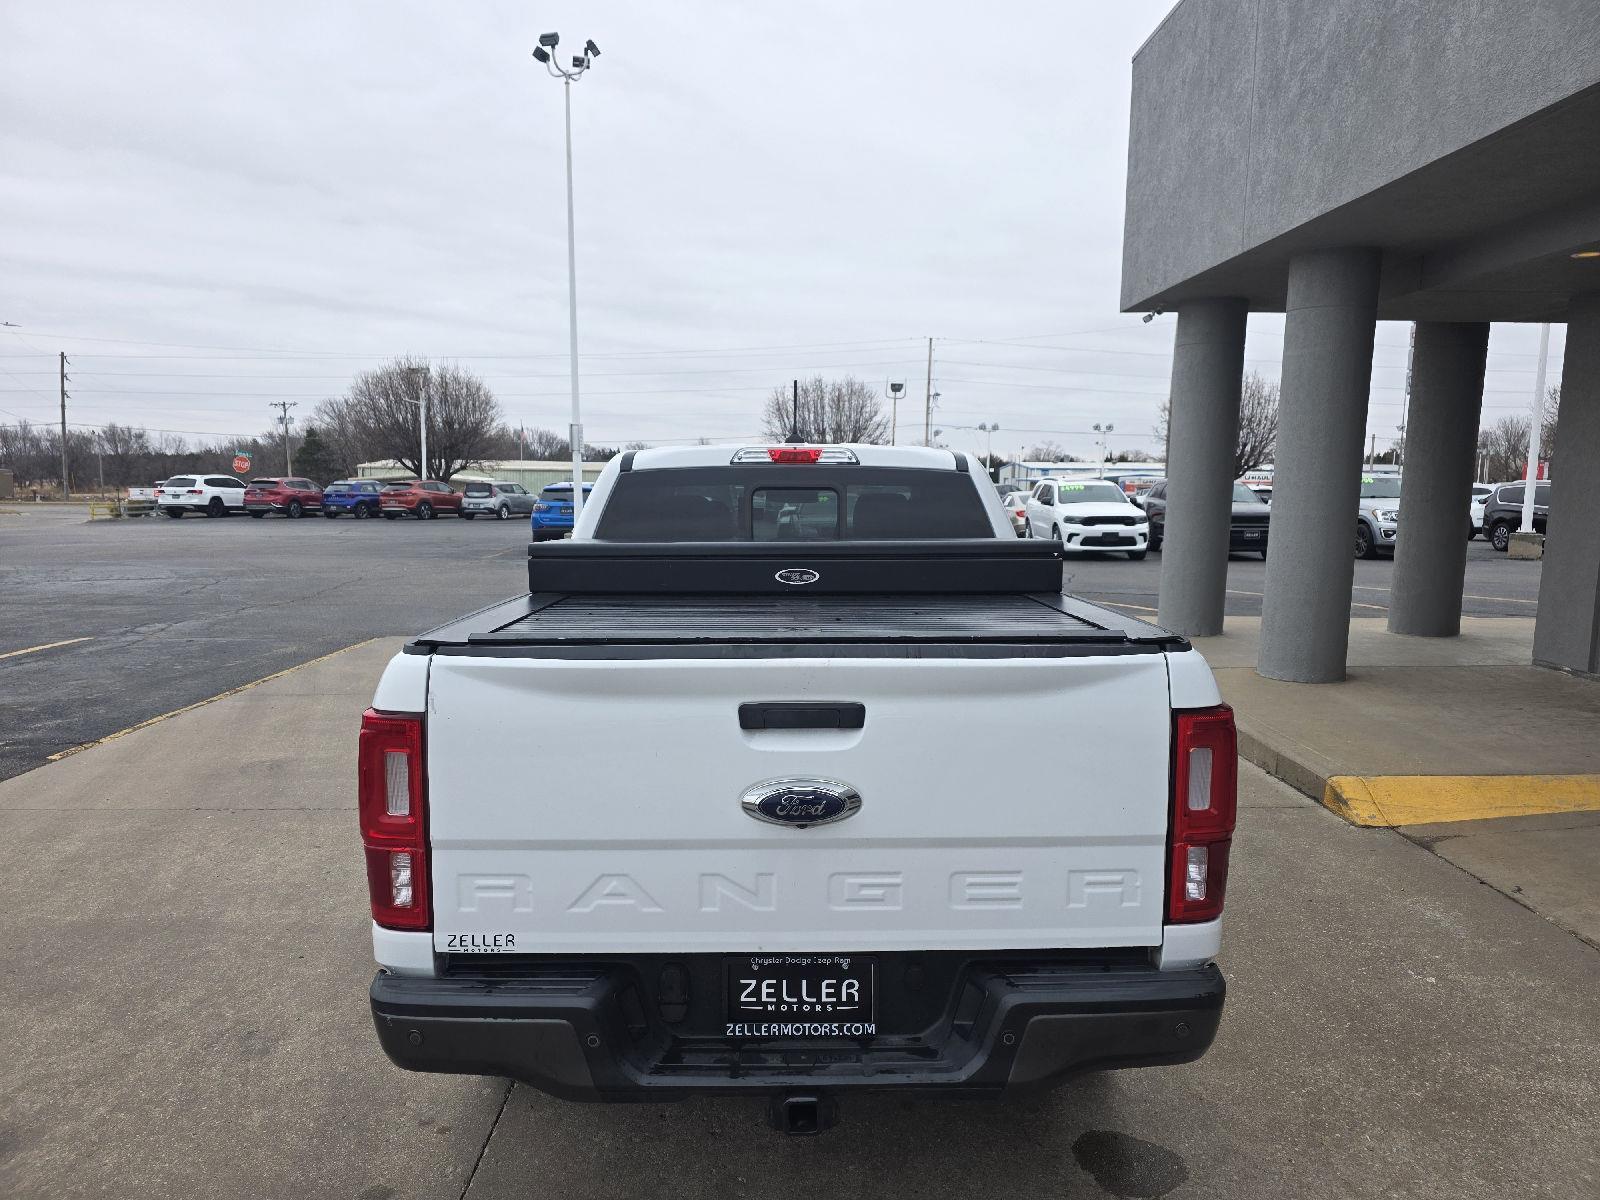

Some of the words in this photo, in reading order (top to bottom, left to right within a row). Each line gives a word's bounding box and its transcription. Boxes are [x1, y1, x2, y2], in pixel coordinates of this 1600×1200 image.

[234, 460, 249, 468] STOP
[776, 794, 827, 815] Ford
[456, 868, 1142, 913] RANGER
[447, 934, 515, 947] ZELLER
[750, 956, 783, 965] Chrysler
[786, 957, 811, 965] Dodge
[834, 956, 851, 964] Ram
[739, 979, 860, 1002] ZELLER
[767, 1004, 833, 1012] MOTORS
[726, 1023, 876, 1036] ZELLERMOTORS.COM
